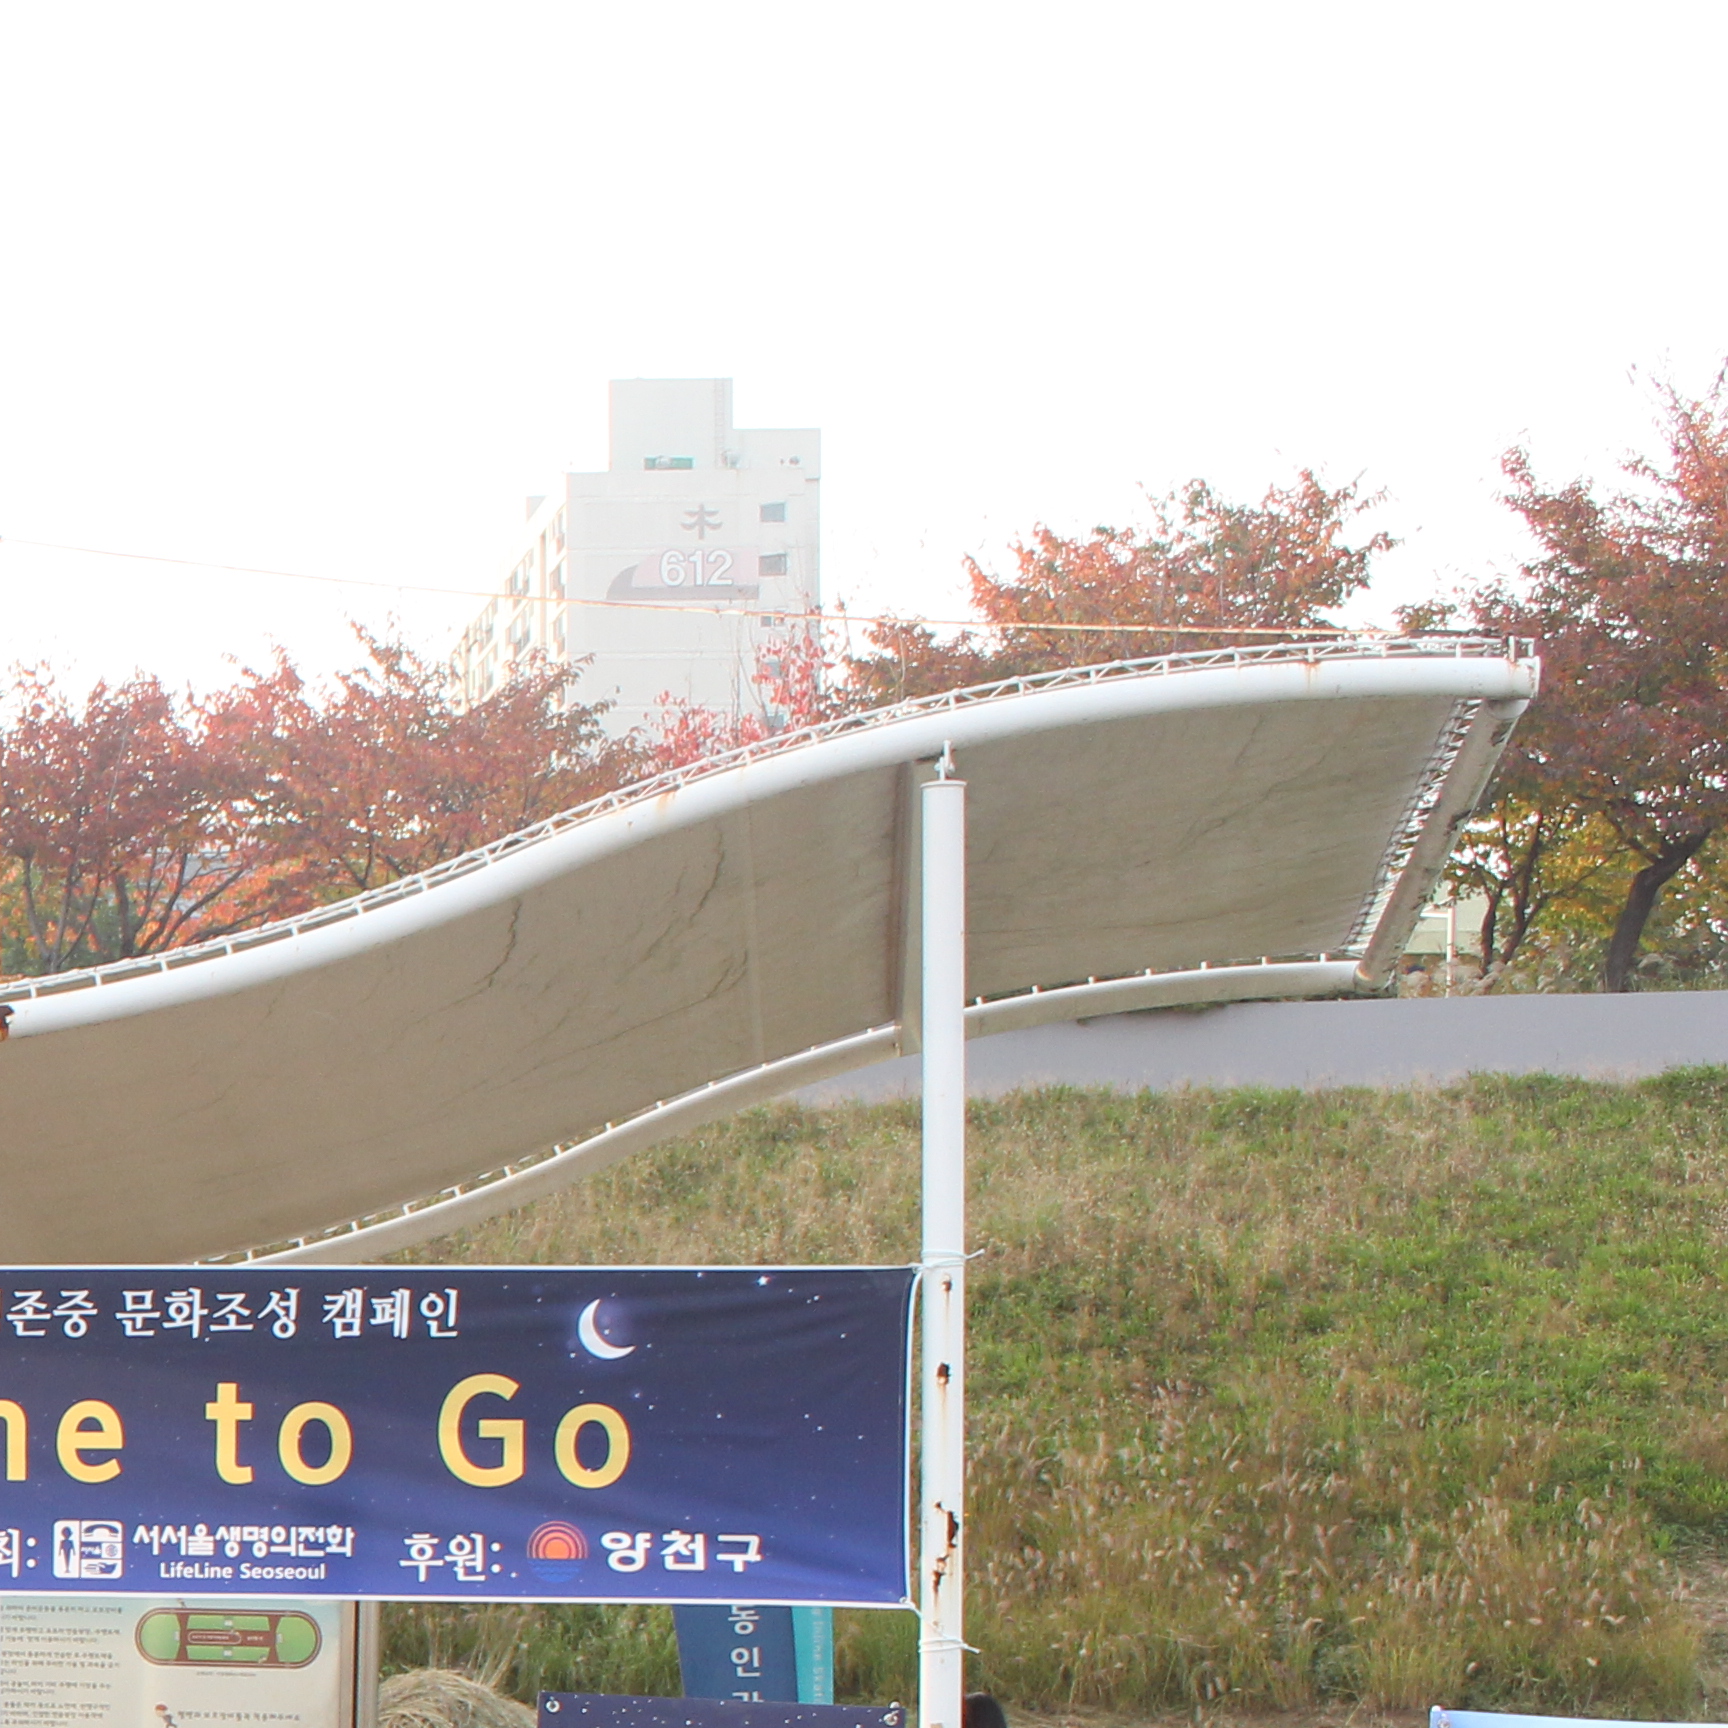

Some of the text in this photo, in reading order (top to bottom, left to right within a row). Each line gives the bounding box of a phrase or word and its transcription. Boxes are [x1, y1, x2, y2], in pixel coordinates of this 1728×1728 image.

[659, 549, 734, 588] 612
[114, 1287, 304, 1340] 문화조성
[319, 1287, 461, 1340] 캠페인
[204, 1381, 353, 1487] to
[437, 1373, 631, 1489] Go
[133, 1522, 355, 1560] 서서울생명의전화
[398, 1531, 504, 1582] 후원:
[600, 1529, 763, 1573] 양천구
[159, 1561, 327, 1581] LifeLine Seoseoul
